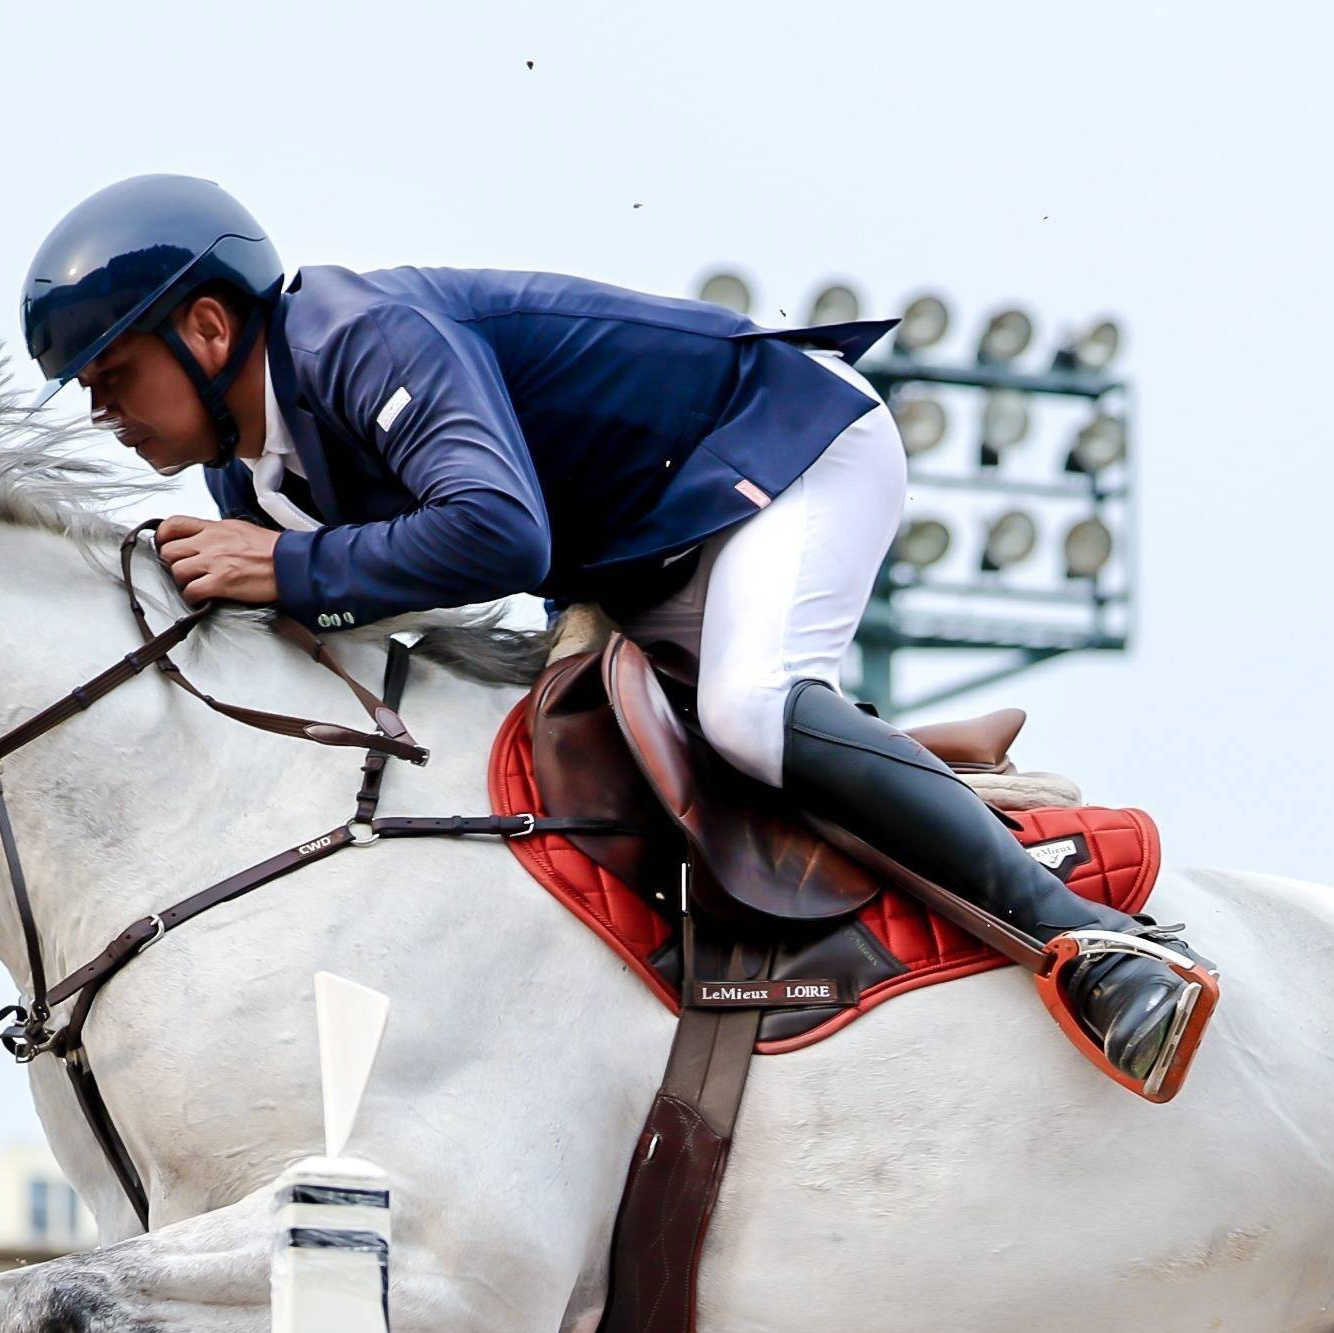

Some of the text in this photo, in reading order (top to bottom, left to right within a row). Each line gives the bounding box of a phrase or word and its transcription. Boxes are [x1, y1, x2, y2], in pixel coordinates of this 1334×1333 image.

[298, 836, 332, 856] CWD
[1034, 845, 1073, 858] eMieux
[701, 986, 830, 1000] LeMieux LOIRE
